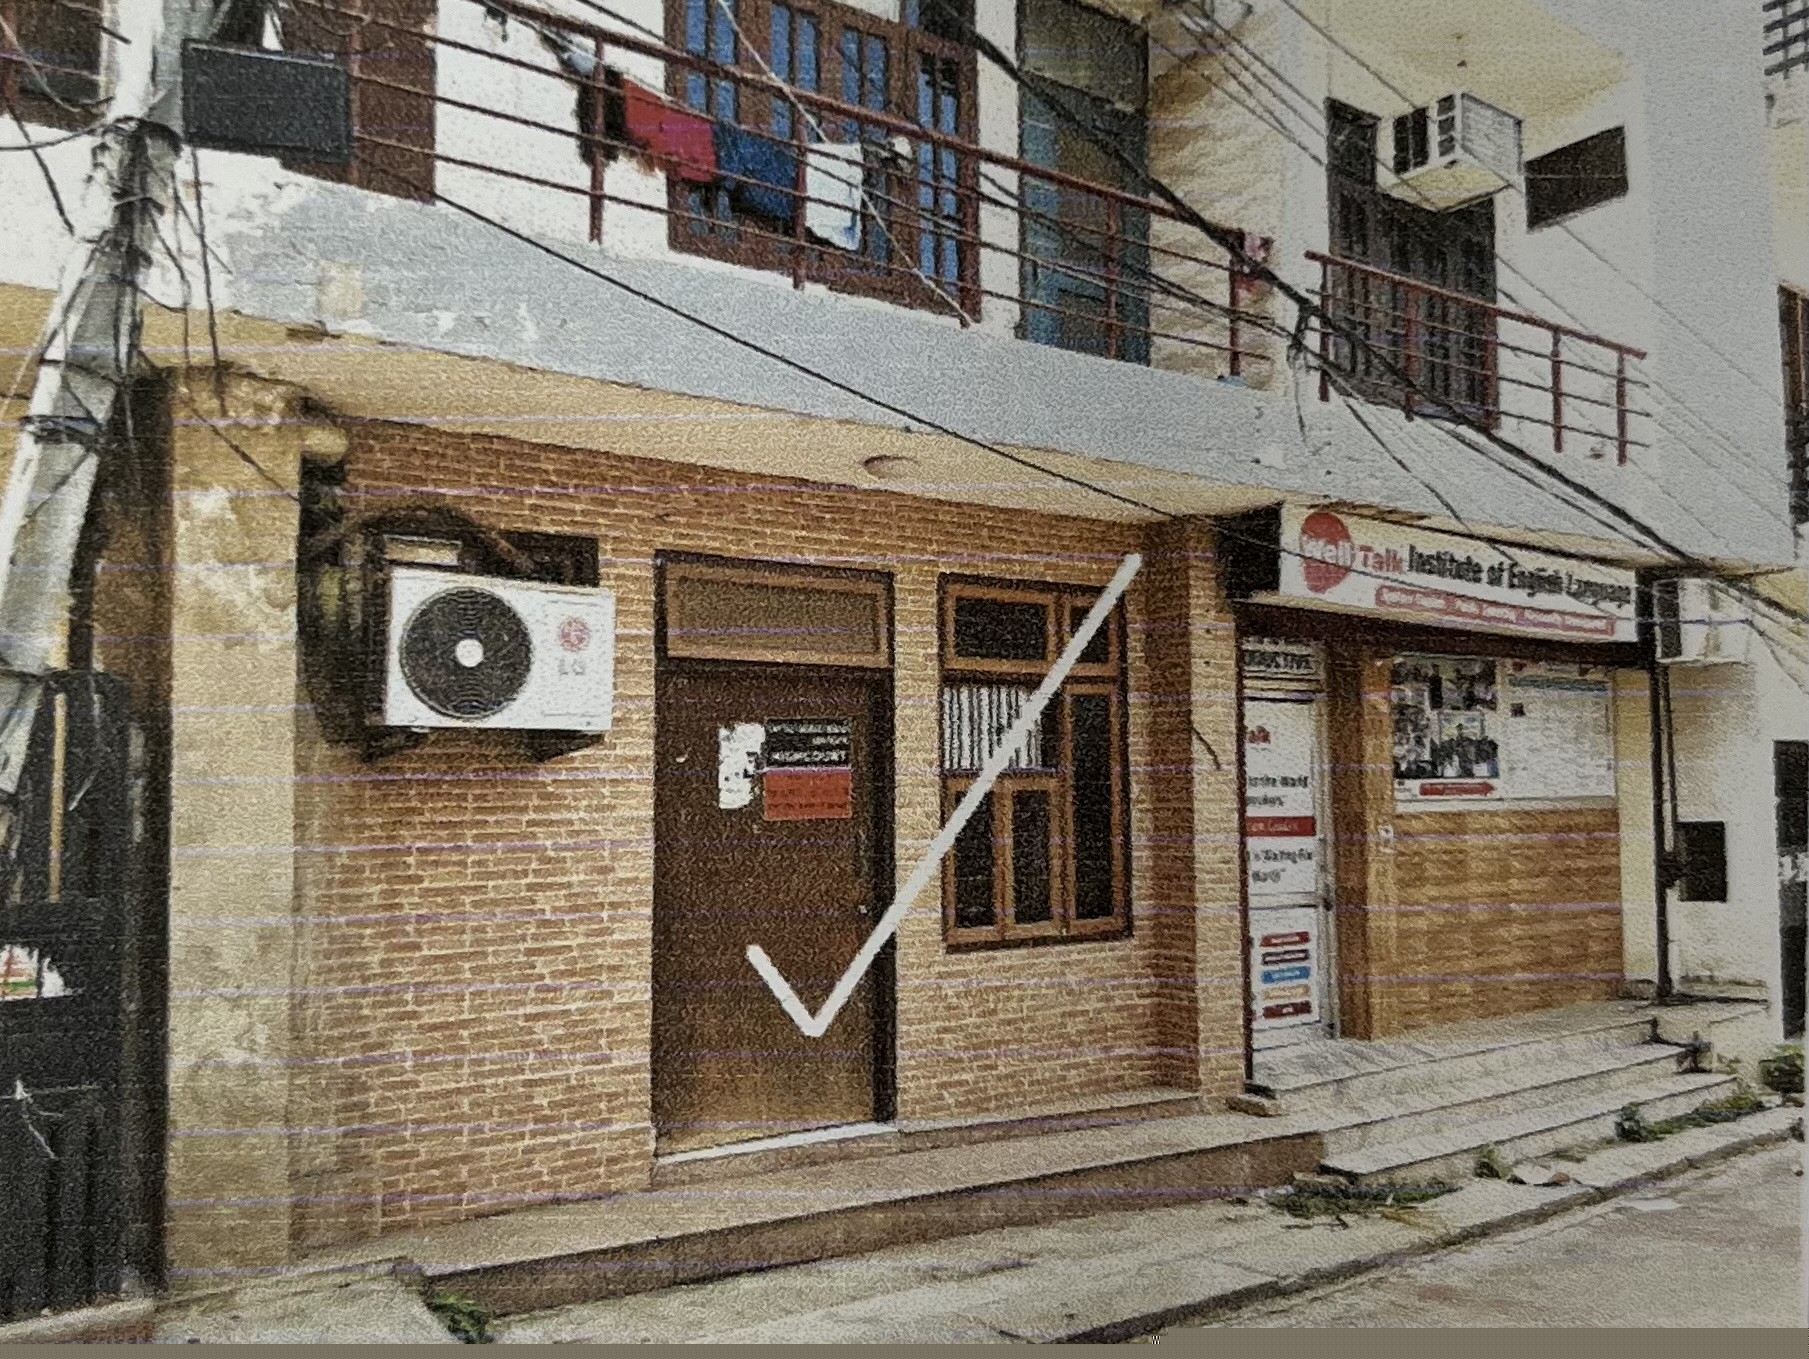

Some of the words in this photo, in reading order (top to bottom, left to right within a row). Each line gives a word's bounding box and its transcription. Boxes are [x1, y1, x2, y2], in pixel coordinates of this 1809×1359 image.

[1301, 536, 1351, 568] Well
[1359, 545, 1403, 573] Talk
[1408, 544, 1483, 583] Institute
[1487, 561, 1504, 586] of
[1508, 562, 1563, 597] English
[1566, 571, 1631, 608] Language
[558, 659, 585, 677] LG
